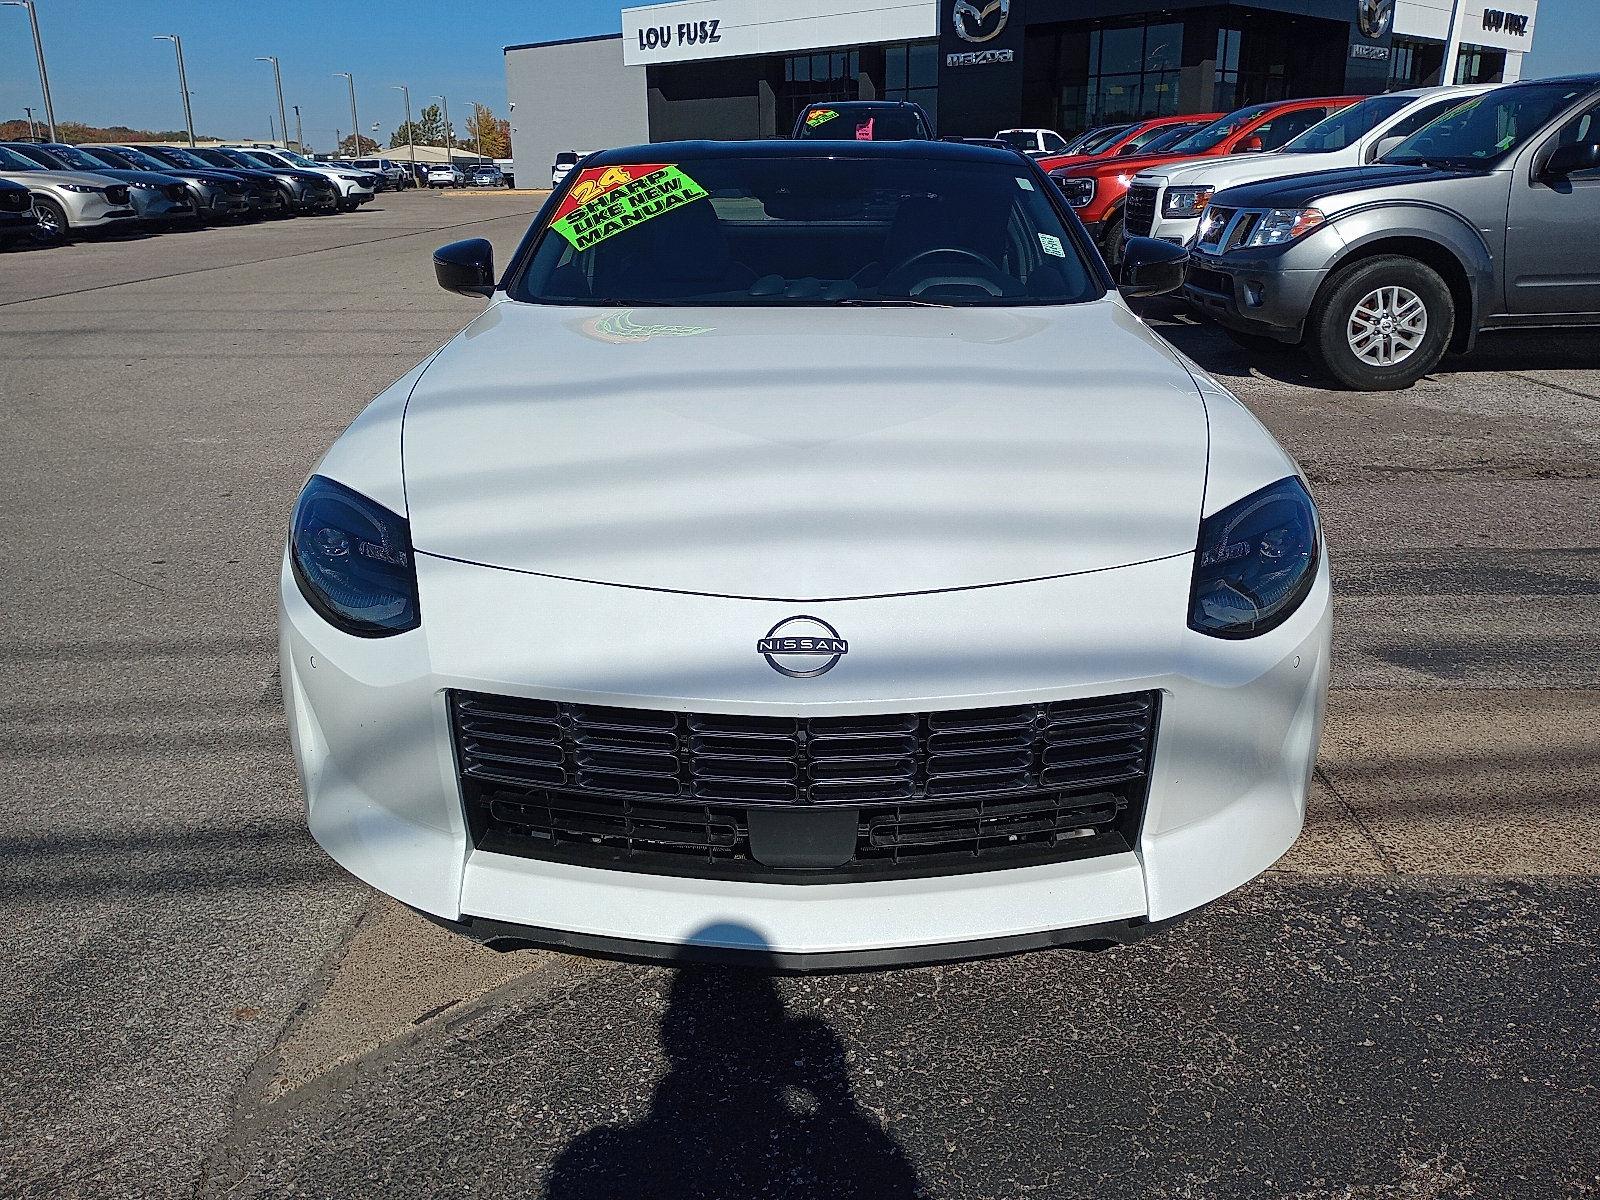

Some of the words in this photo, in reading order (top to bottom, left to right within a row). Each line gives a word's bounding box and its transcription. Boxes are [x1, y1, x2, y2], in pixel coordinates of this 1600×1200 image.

[638, 26, 672, 51] LOU
[678, 19, 721, 47] FUSZ
[565, 170, 669, 225] SHARP
[570, 165, 633, 205] 24
[572, 202, 627, 236] LIKE
[629, 177, 683, 208] NEW
[576, 188, 705, 249] MANUAL
[760, 639, 846, 651] NISSAN
